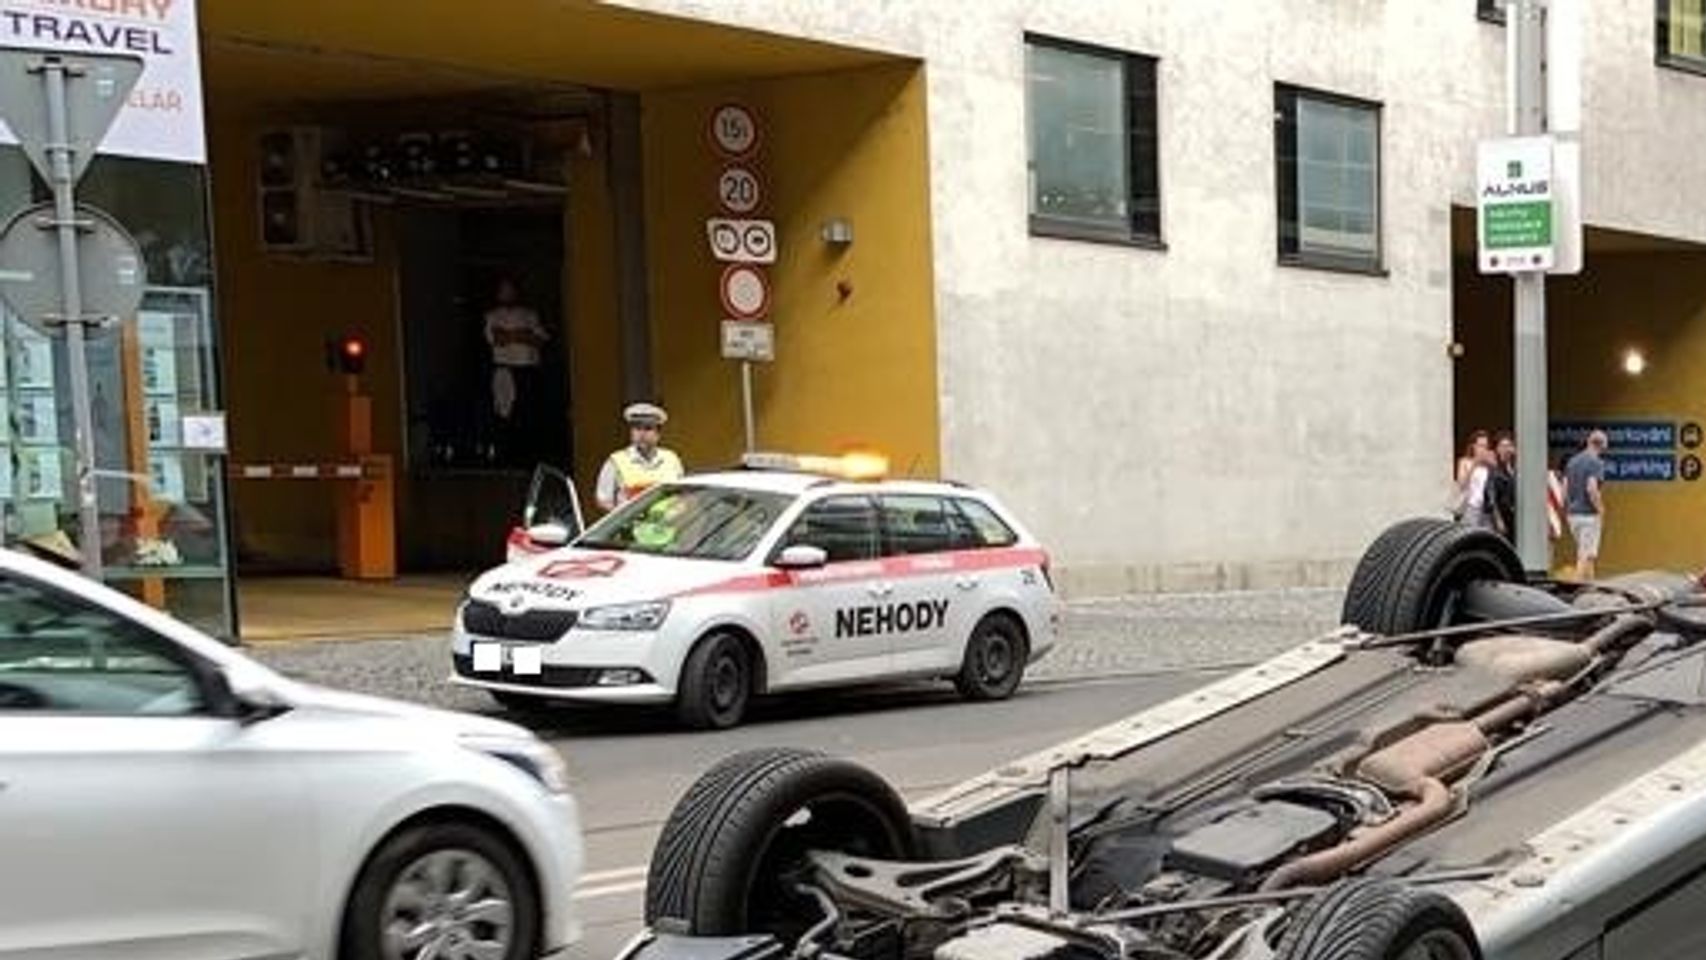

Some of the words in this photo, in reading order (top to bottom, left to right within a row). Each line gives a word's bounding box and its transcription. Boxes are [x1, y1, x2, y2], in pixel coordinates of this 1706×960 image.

[3, 10, 173, 55] TRAVEL
[723, 176, 751, 201] 20
[834, 599, 950, 639] NEHODY
